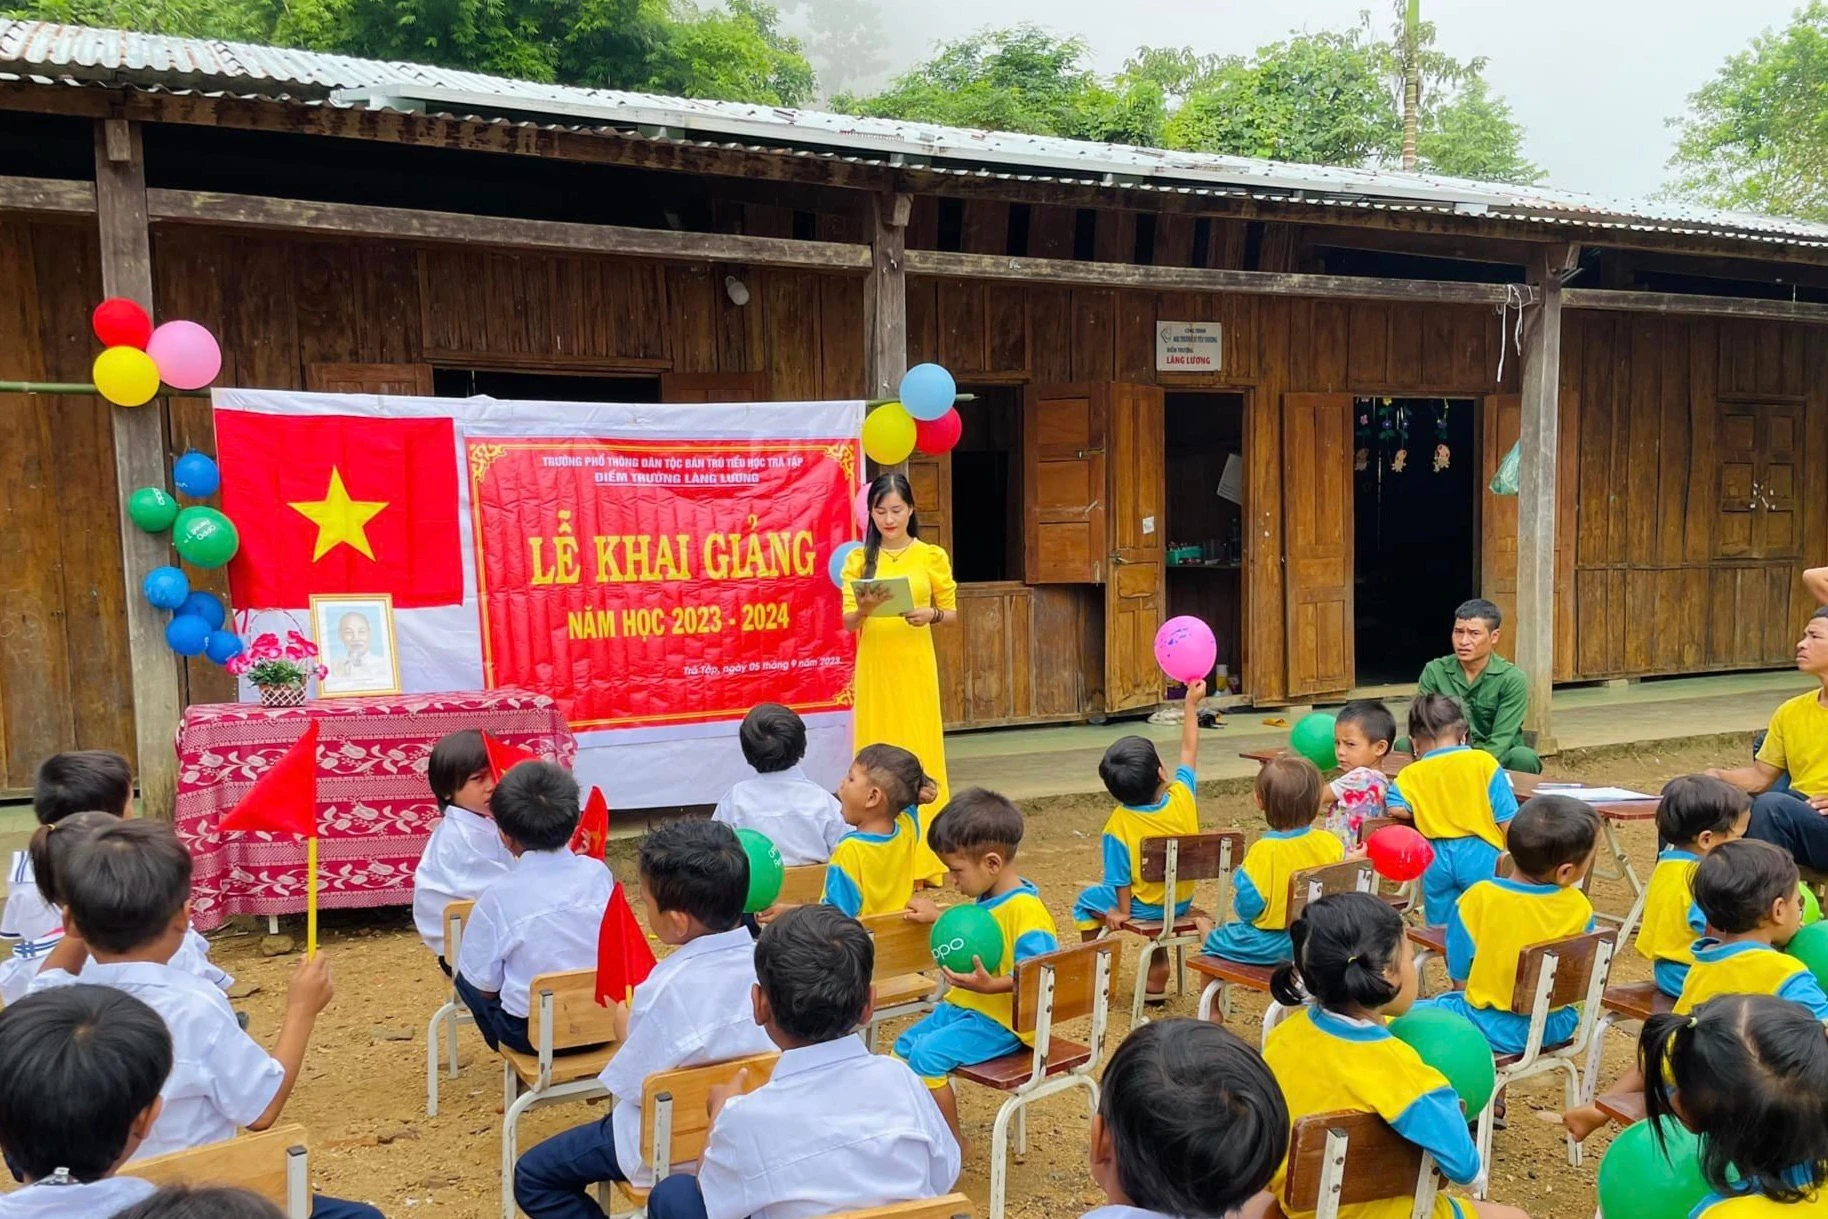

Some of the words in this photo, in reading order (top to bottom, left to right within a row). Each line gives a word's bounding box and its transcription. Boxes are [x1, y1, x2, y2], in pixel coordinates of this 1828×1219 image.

[543, 455, 582, 467] TRƯỜNG
[584, 453, 605, 467] PHỔ
[607, 455, 639, 468] THÔNG
[641, 456, 662, 468] DÂN
[664, 457, 682, 470] TỘC
[747, 457, 765, 469] HỌC
[595, 469, 628, 482] ĐIỂM
[630, 470, 681, 483] TRƯỜNG
[684, 472, 717, 484] LÀNG
[720, 472, 759, 484] LƯƠNG
[528, 509, 581, 585] LỄ
[593, 534, 692, 583] KHAI
[704, 513, 816, 580] GIẢNG
[568, 604, 616, 639] NĂM
[622, 607, 665, 642] HỌC
[671, 605, 722, 635] 2023
[742, 602, 789, 631] 2024
[723, 664, 746, 675] ngày
[749, 662, 760, 671] 05
[763, 660, 789, 671] tháng
[791, 659, 796, 668] 9
[798, 657, 817, 667] năm
